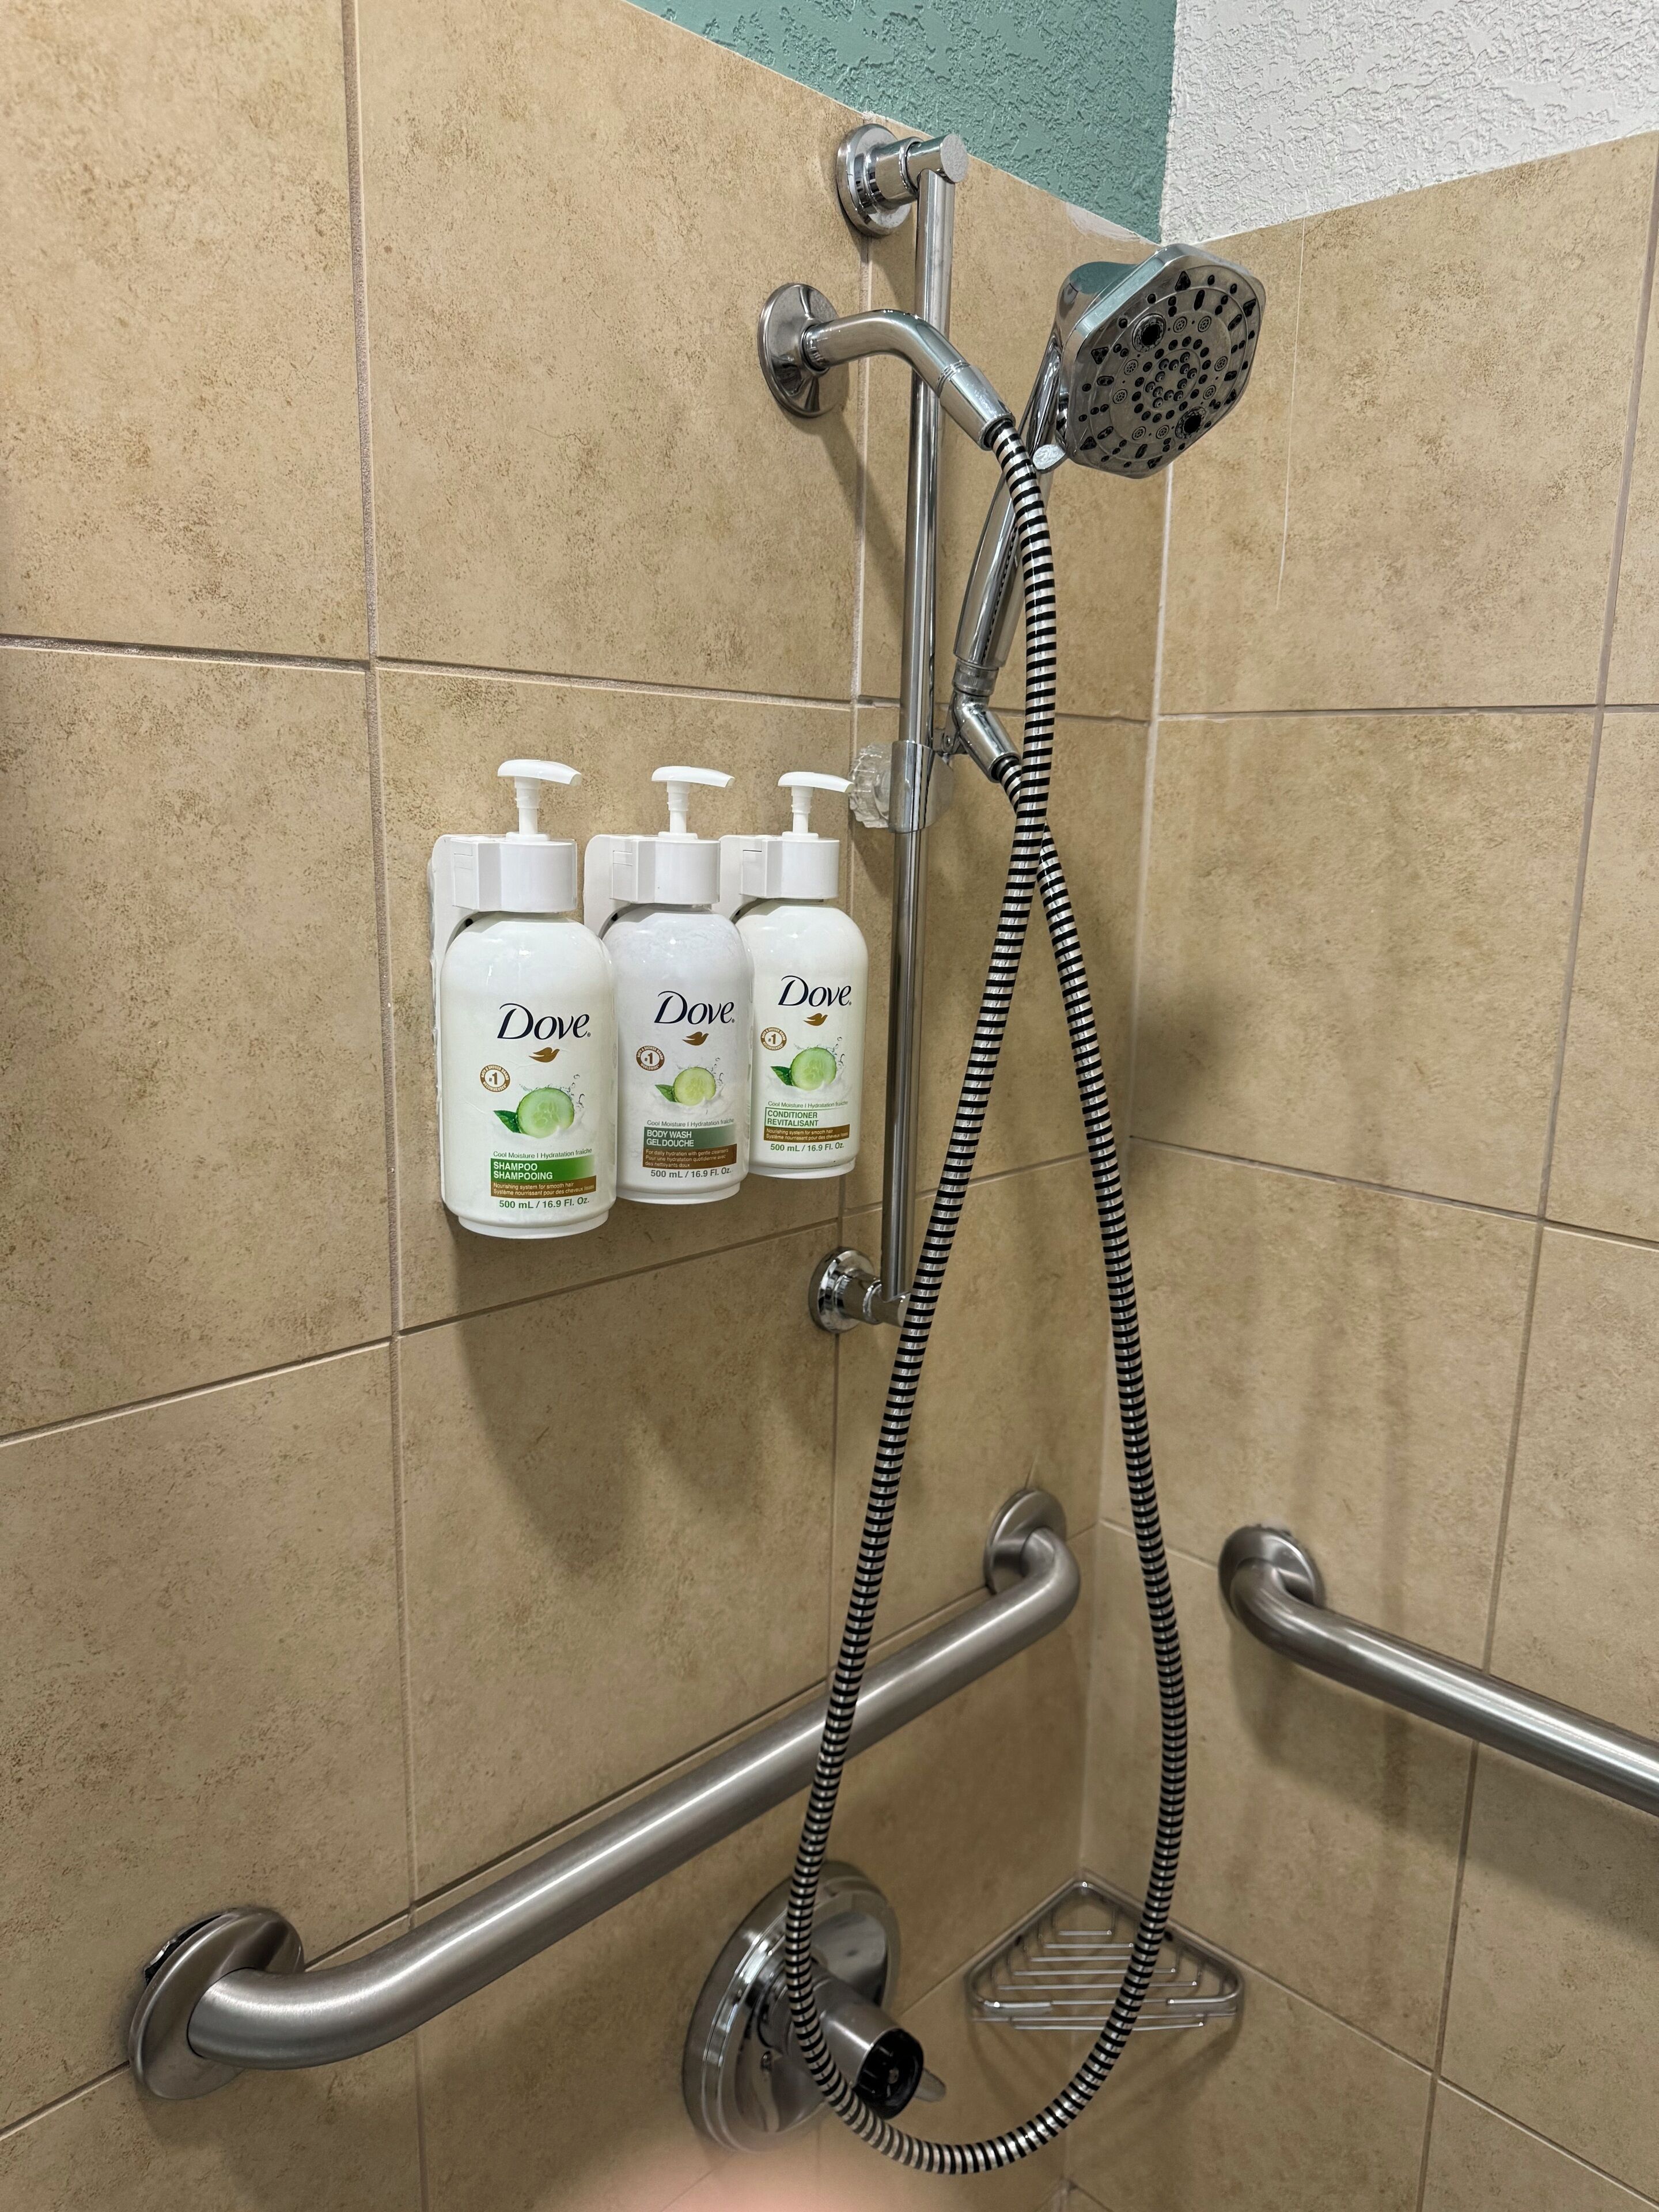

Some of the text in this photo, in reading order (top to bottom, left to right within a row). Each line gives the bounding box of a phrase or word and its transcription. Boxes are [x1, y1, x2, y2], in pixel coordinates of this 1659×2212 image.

[778, 975, 851, 1007] Dove
[654, 991, 734, 1024] Dove
[497, 1003, 590, 1040] Dove
[768, 1110, 817, 1118] CONDITIONER
[767, 1118, 819, 1126] REVITALISANT
[647, 1130, 668, 1138] BODY
[541, 1151, 574, 1159] Hydratation
[494, 1161, 537, 1171] SHAMPOO
[494, 1171, 552, 1180] SHAMPOOING
[543, 1200, 561, 1208] 16.9
